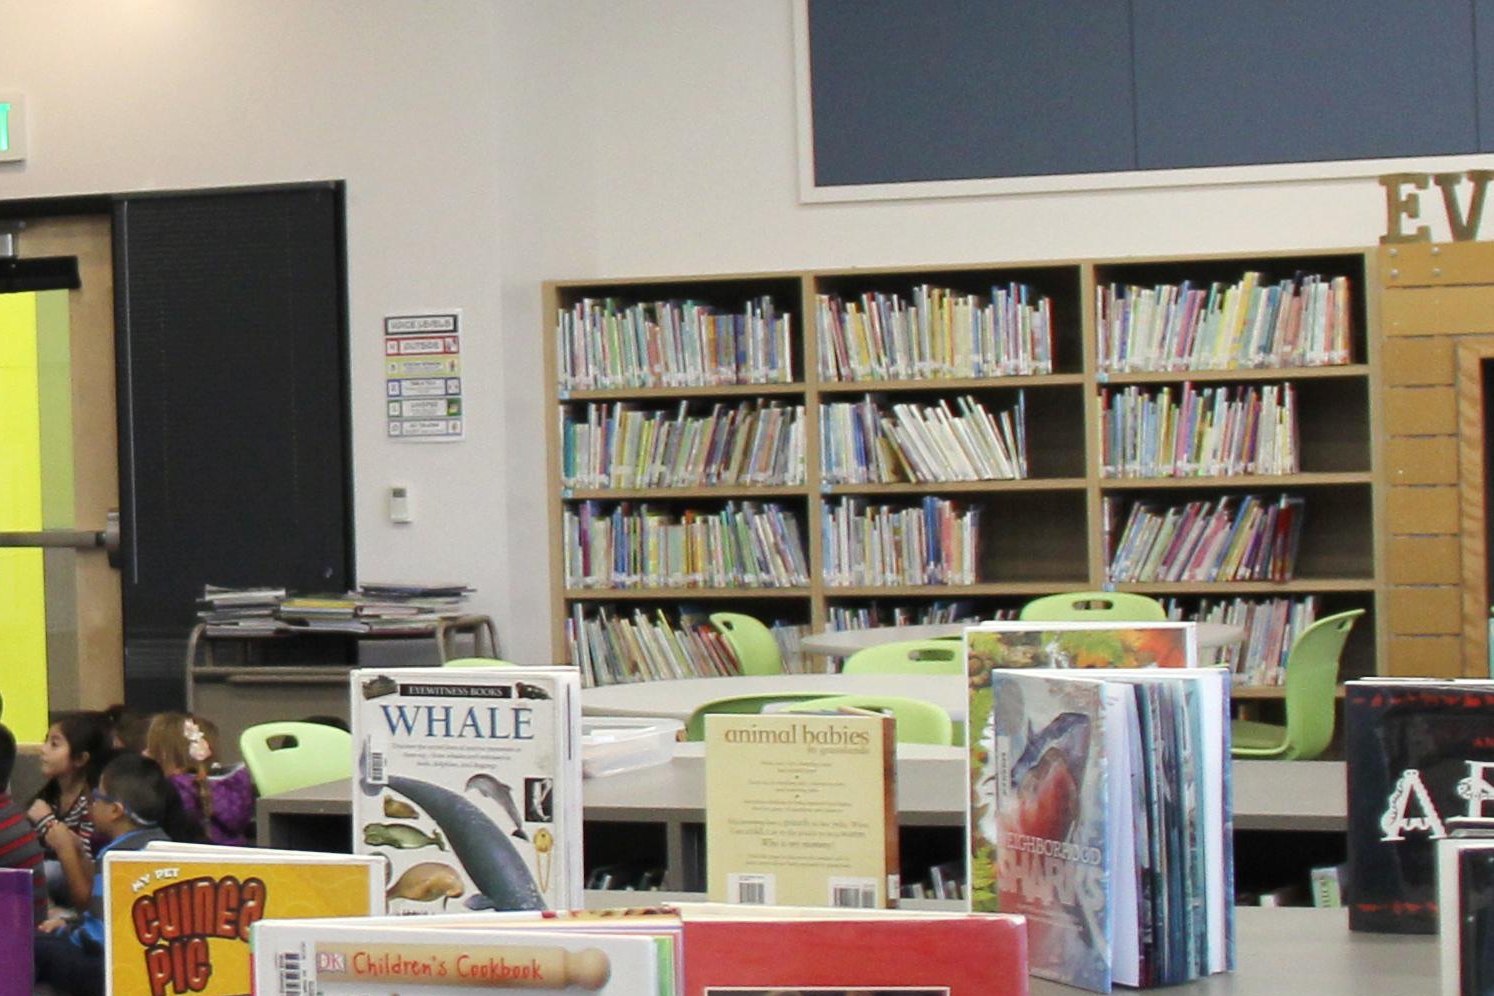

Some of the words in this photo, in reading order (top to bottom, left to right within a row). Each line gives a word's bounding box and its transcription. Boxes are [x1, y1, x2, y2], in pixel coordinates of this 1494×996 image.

[470, 687, 503, 696] BOOKS
[379, 704, 534, 740] WHALE
[724, 724, 796, 744] animal
[802, 724, 870, 745] babies
[1003, 831, 1103, 865] EIGHBORHOOD
[131, 874, 151, 892] MY
[154, 867, 180, 879] PET
[317, 952, 345, 972] DK
[352, 951, 448, 978] Children's
[456, 953, 545, 981] Cookbook
